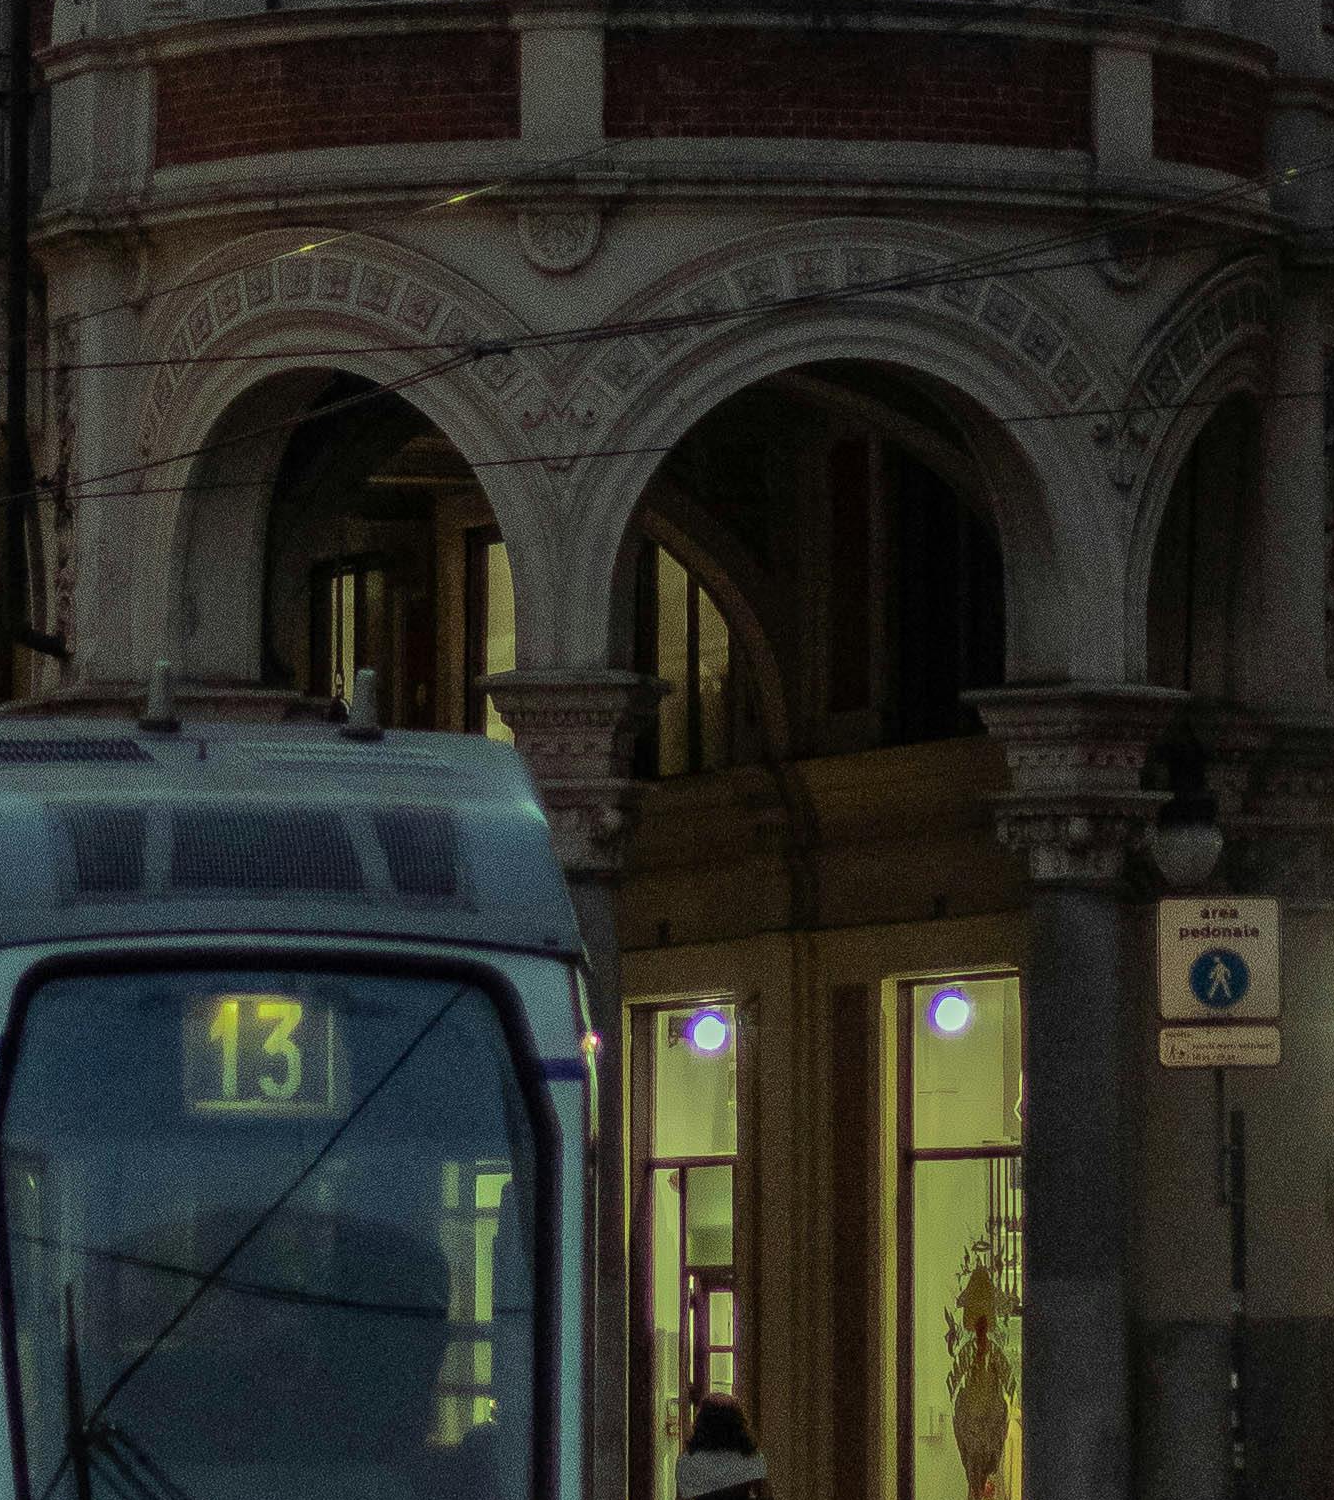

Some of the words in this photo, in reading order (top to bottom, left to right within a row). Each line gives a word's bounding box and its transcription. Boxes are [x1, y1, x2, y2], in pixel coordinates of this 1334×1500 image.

[1200, 907, 1239, 919] area
[1179, 924, 1260, 941] pedonale
[208, 1000, 304, 1099] 13
